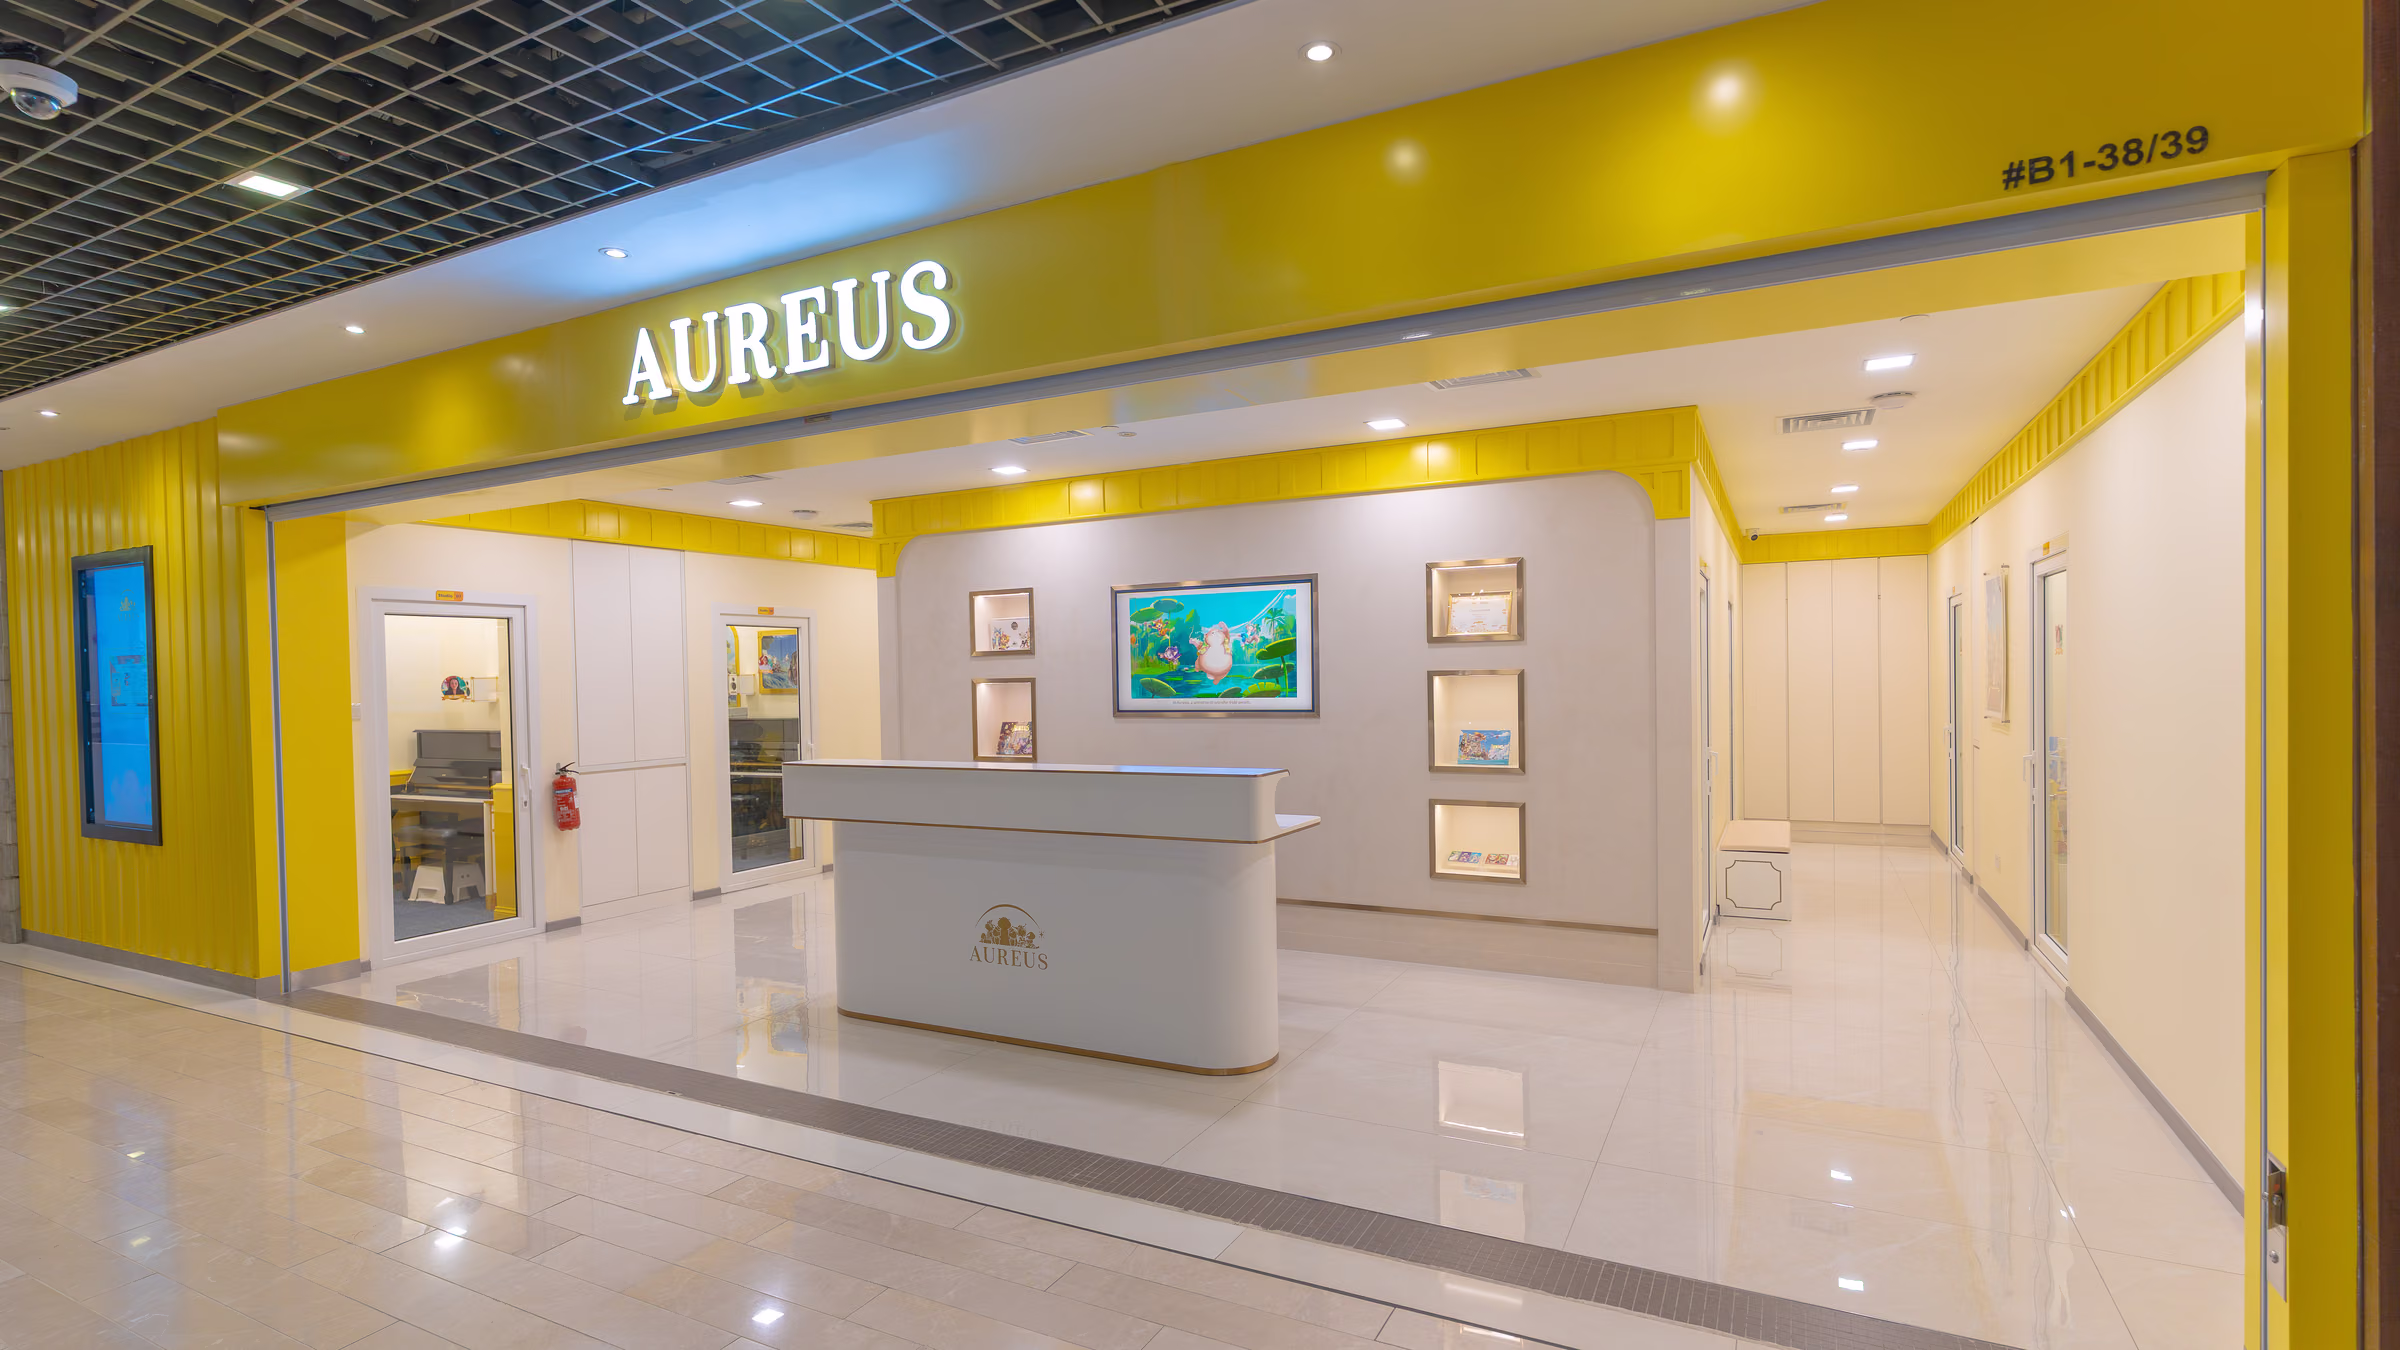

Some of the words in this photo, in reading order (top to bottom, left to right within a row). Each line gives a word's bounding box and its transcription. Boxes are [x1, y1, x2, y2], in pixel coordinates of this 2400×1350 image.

[2002, 125, 2209, 191] #B1-38/39
[622, 259, 951, 405] AUREUS
[969, 945, 1048, 970] AUREUS
